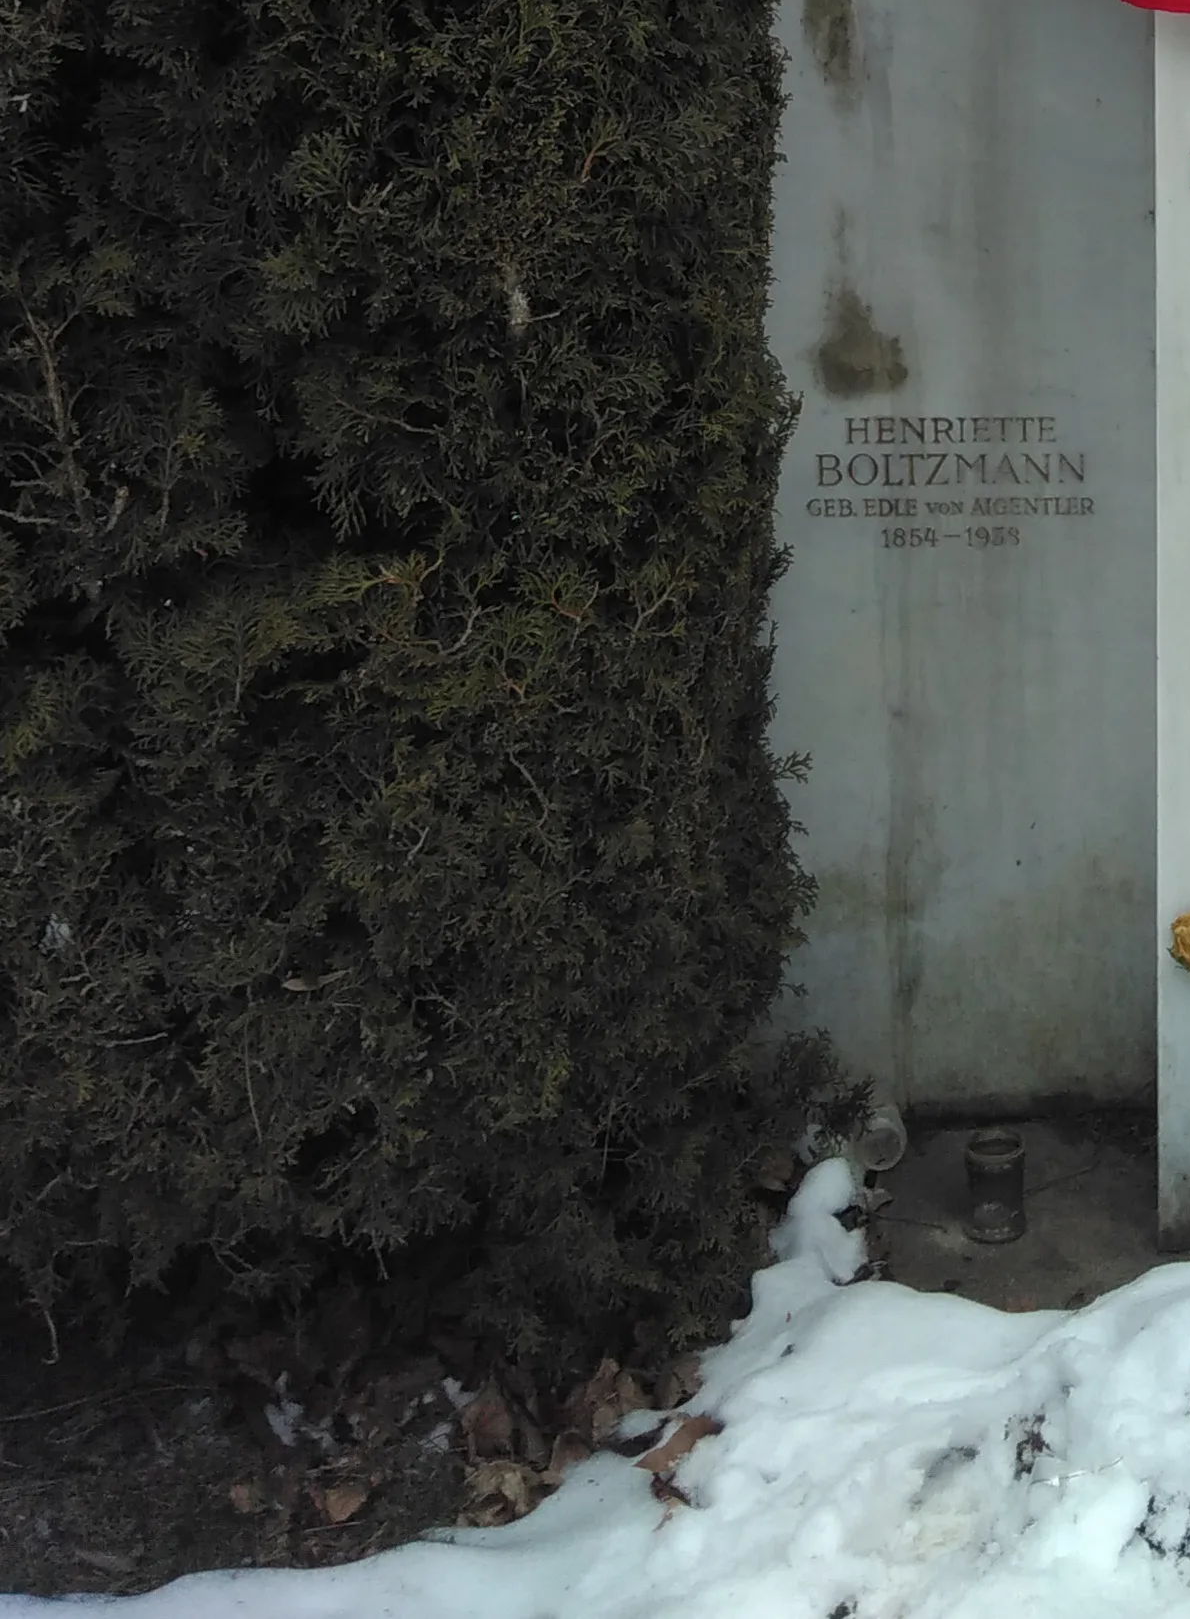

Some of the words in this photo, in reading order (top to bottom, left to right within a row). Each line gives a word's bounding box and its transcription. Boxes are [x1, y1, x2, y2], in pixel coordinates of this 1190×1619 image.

[844, 416, 1060, 445] HENRIETTE
[815, 452, 1088, 487] BOLTZMANN
[805, 497, 858, 518] GEB.
[863, 498, 919, 518] EDLE
[969, 496, 1096, 517] AIGENTLER
